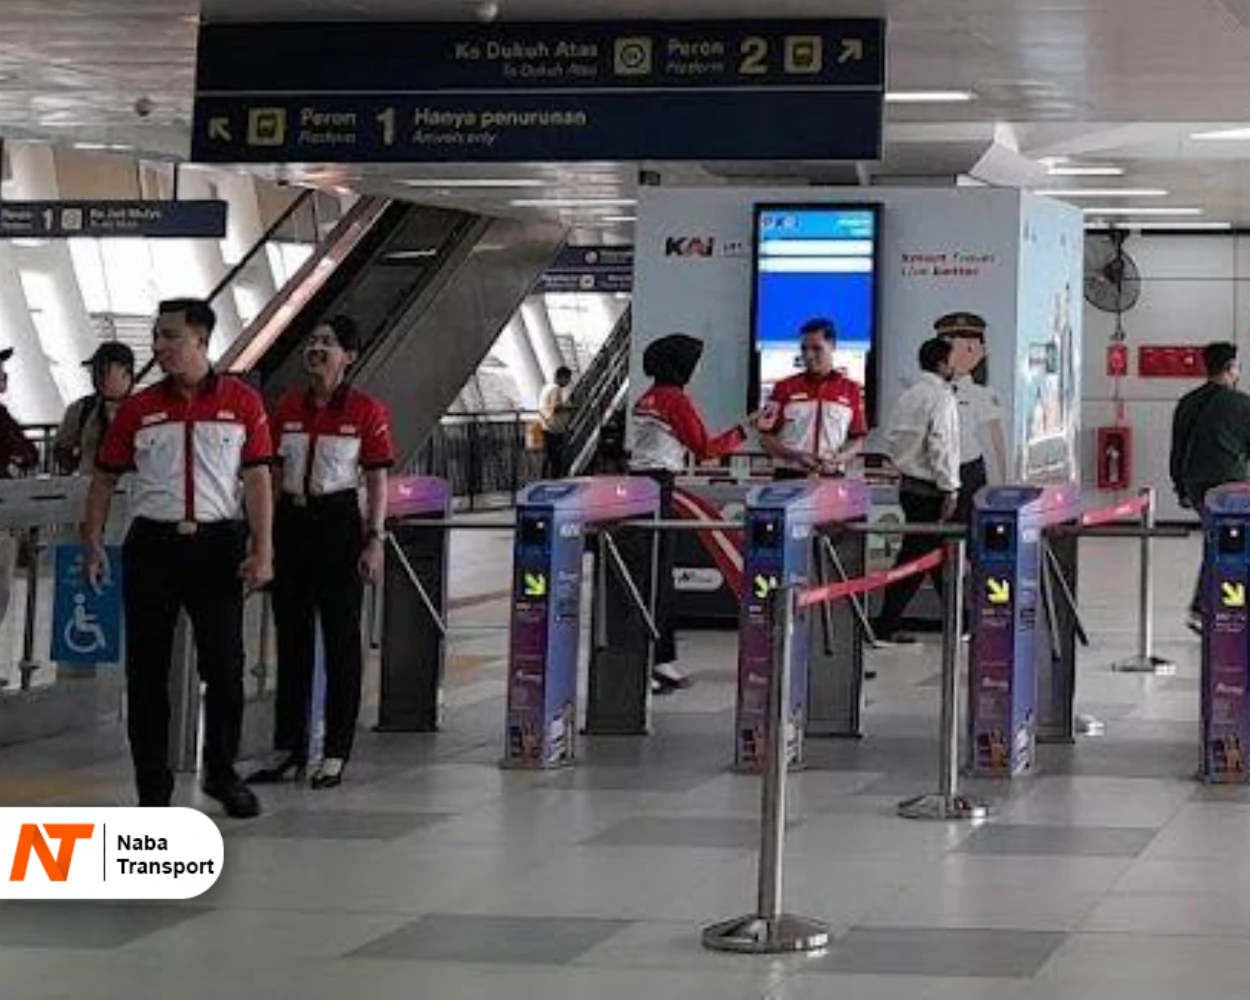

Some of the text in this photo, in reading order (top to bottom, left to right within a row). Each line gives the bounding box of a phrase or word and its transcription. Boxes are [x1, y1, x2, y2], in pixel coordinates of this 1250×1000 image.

[554, 40, 598, 58] Atas
[668, 36, 768, 75] Peron 2
[300, 106, 587, 146] Peron 1 Hanya penurunan
